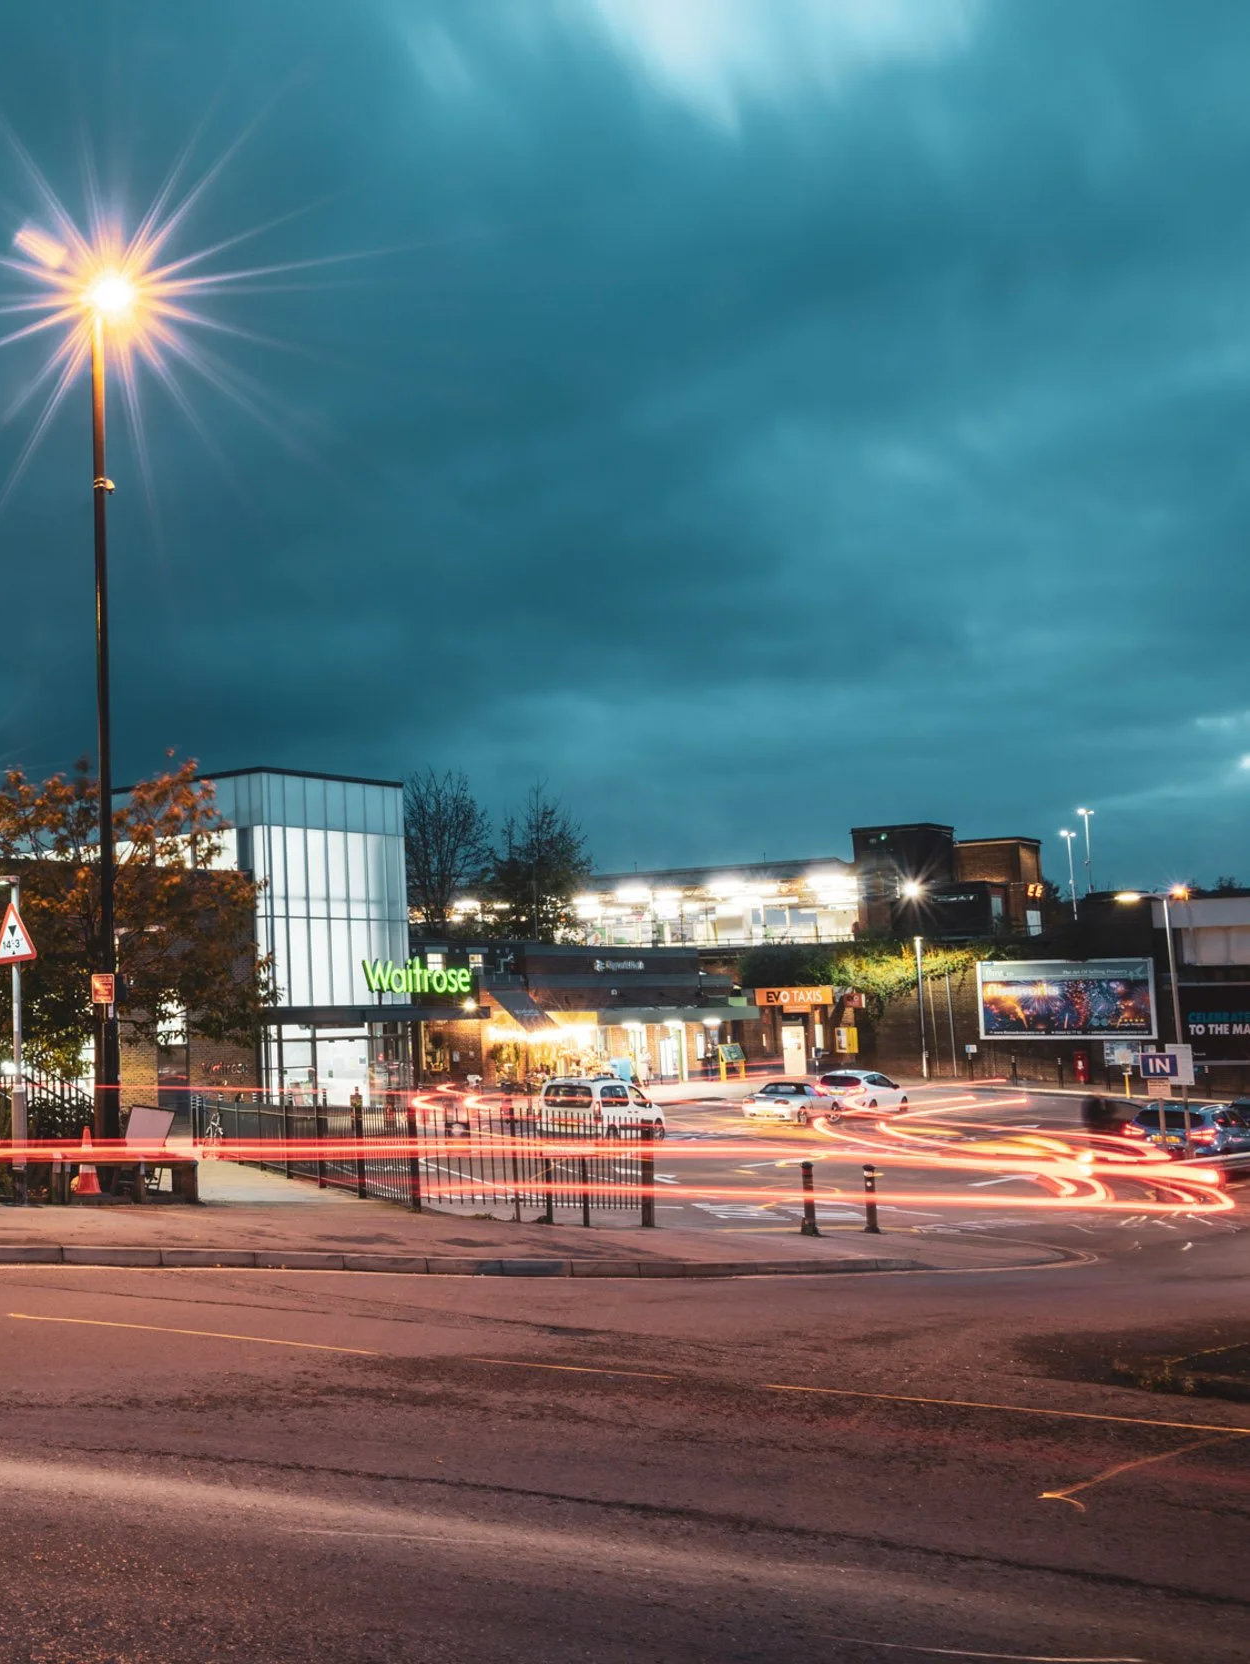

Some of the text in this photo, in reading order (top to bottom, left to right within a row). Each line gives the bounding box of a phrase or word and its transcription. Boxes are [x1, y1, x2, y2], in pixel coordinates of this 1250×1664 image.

[361, 956, 471, 993] Waitrose
[766, 990, 823, 1003] EVO TAXIS
[1189, 1024, 1206, 1036] TO
[1208, 1023, 1230, 1035] THE
[1148, 1058, 1171, 1074] IN
